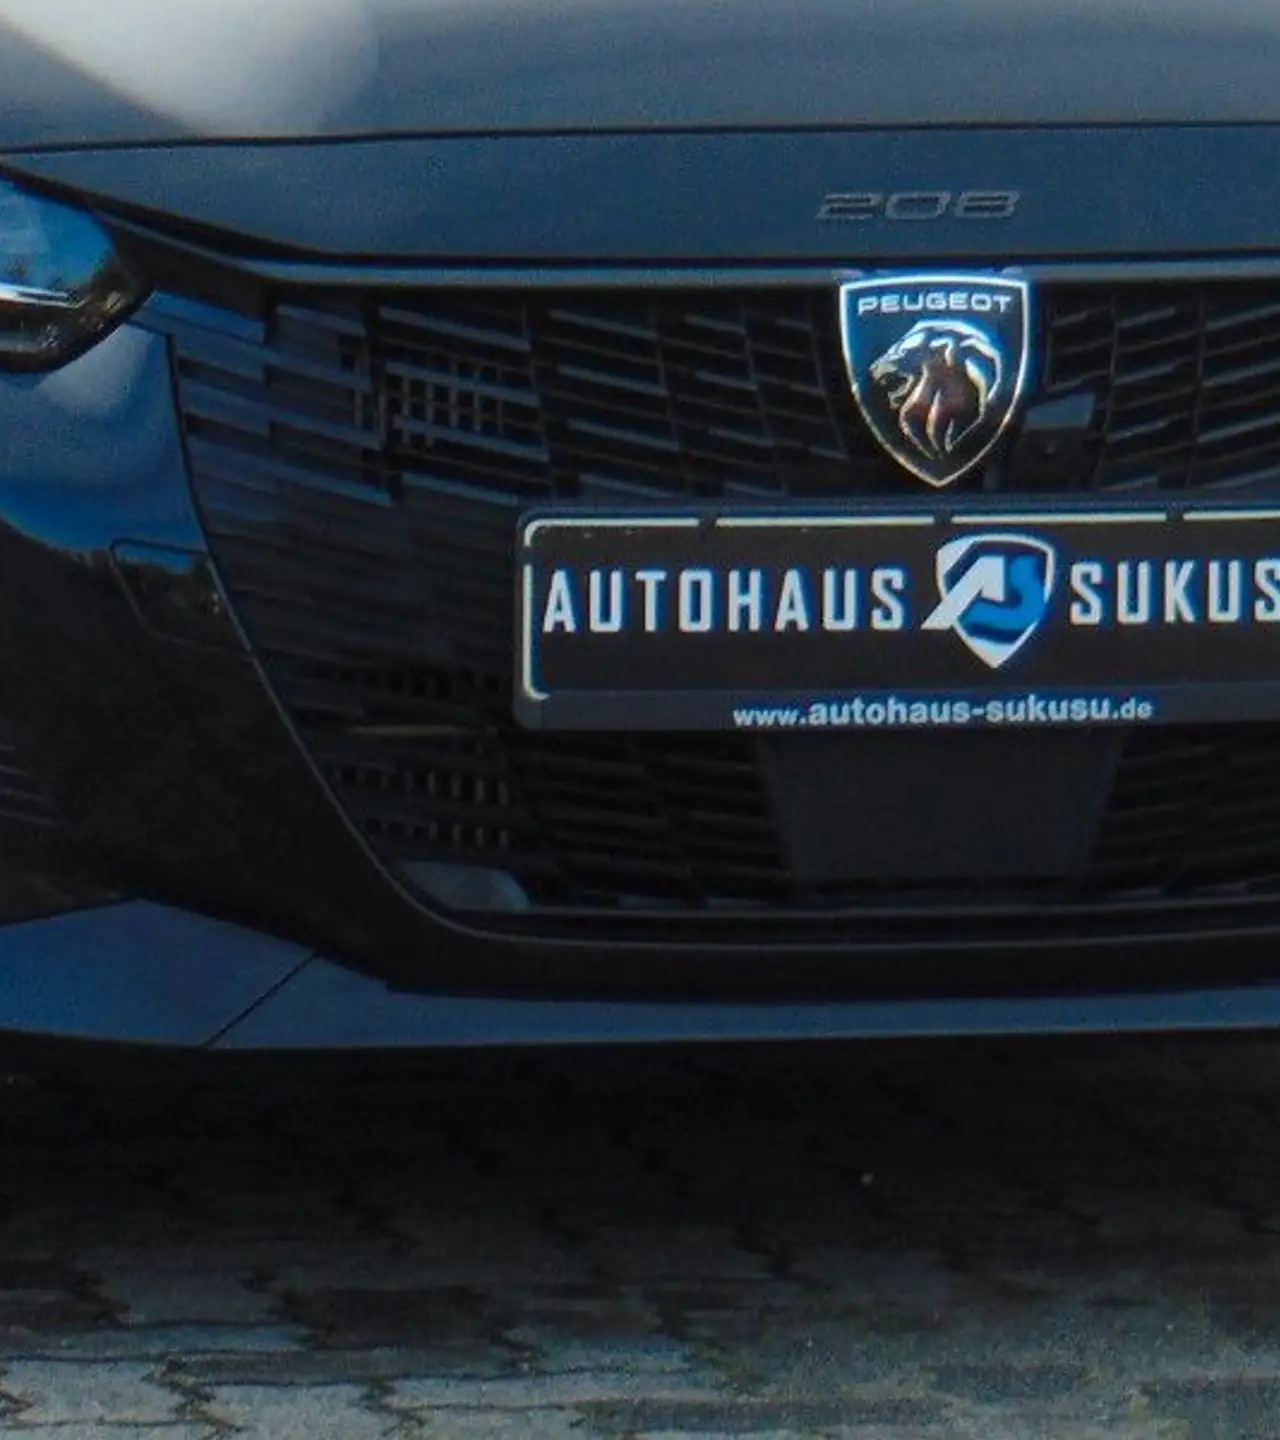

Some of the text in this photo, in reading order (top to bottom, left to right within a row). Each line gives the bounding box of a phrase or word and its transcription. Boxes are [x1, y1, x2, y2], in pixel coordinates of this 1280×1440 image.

[816, 190, 1020, 219] 208
[857, 291, 1012, 316] PEUGEOT
[542, 568, 905, 633] AUTOHAUS
[733, 691, 1153, 728] www.autohaus-sukusu.de
